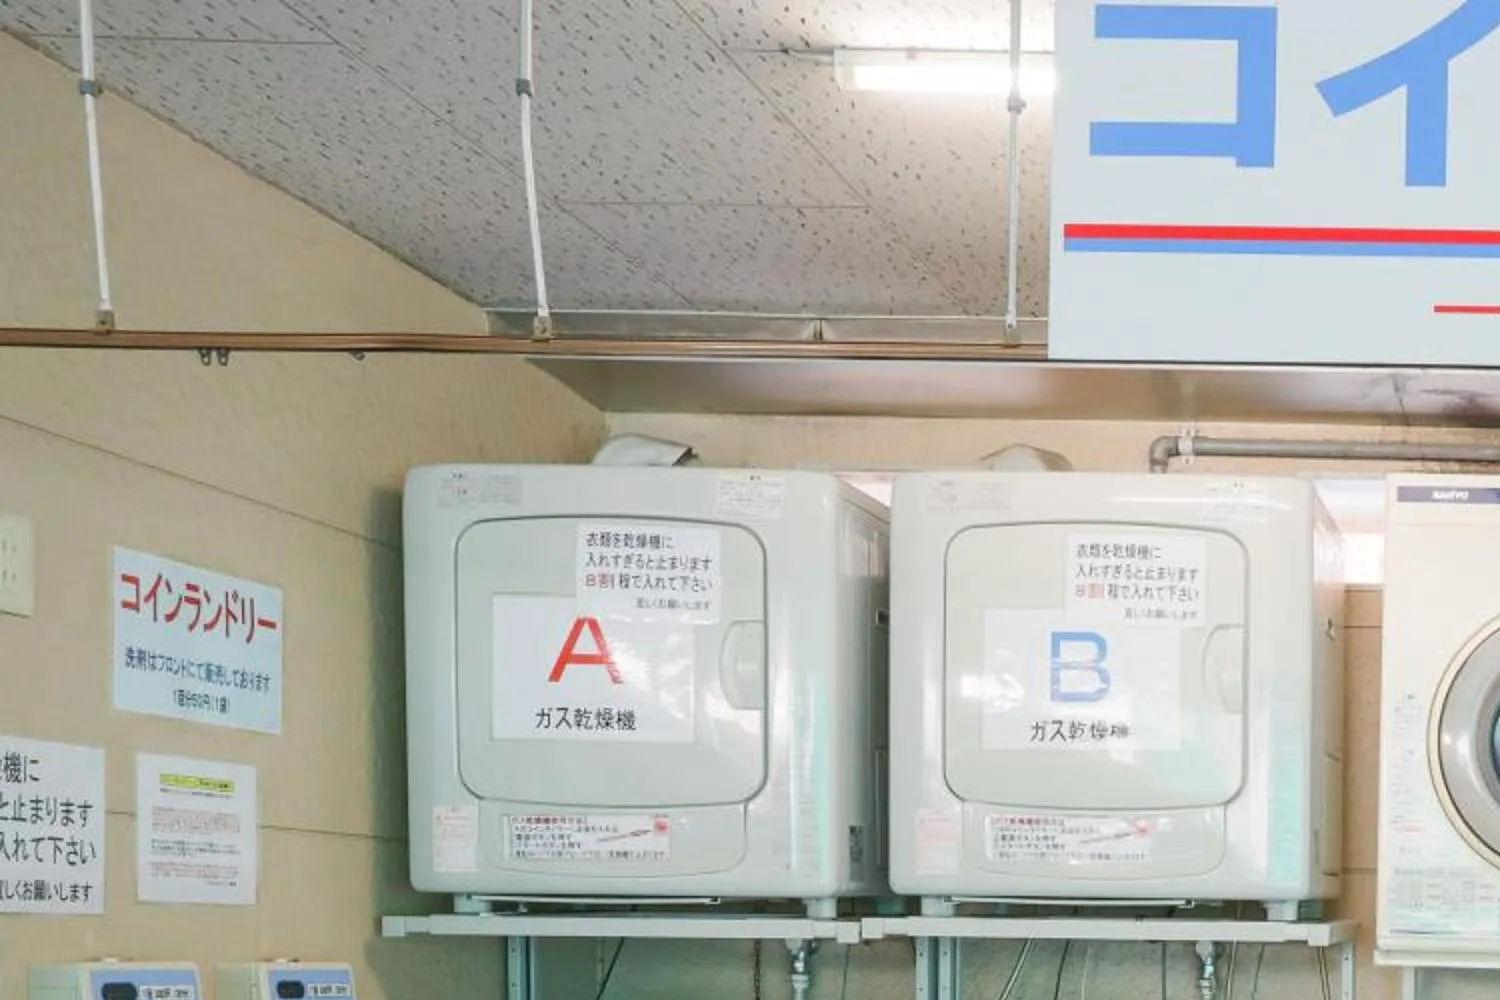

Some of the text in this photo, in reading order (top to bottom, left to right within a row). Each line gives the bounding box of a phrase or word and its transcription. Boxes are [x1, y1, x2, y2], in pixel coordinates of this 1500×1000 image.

[585, 551, 713, 571] 入れすぎると止まります
[120, 573, 277, 644] コインランドリー
[548, 616, 624, 685] A
[1050, 631, 1111, 703] B
[534, 707, 637, 732] ガス乾燥機
[0, 751, 40, 783] 機に
